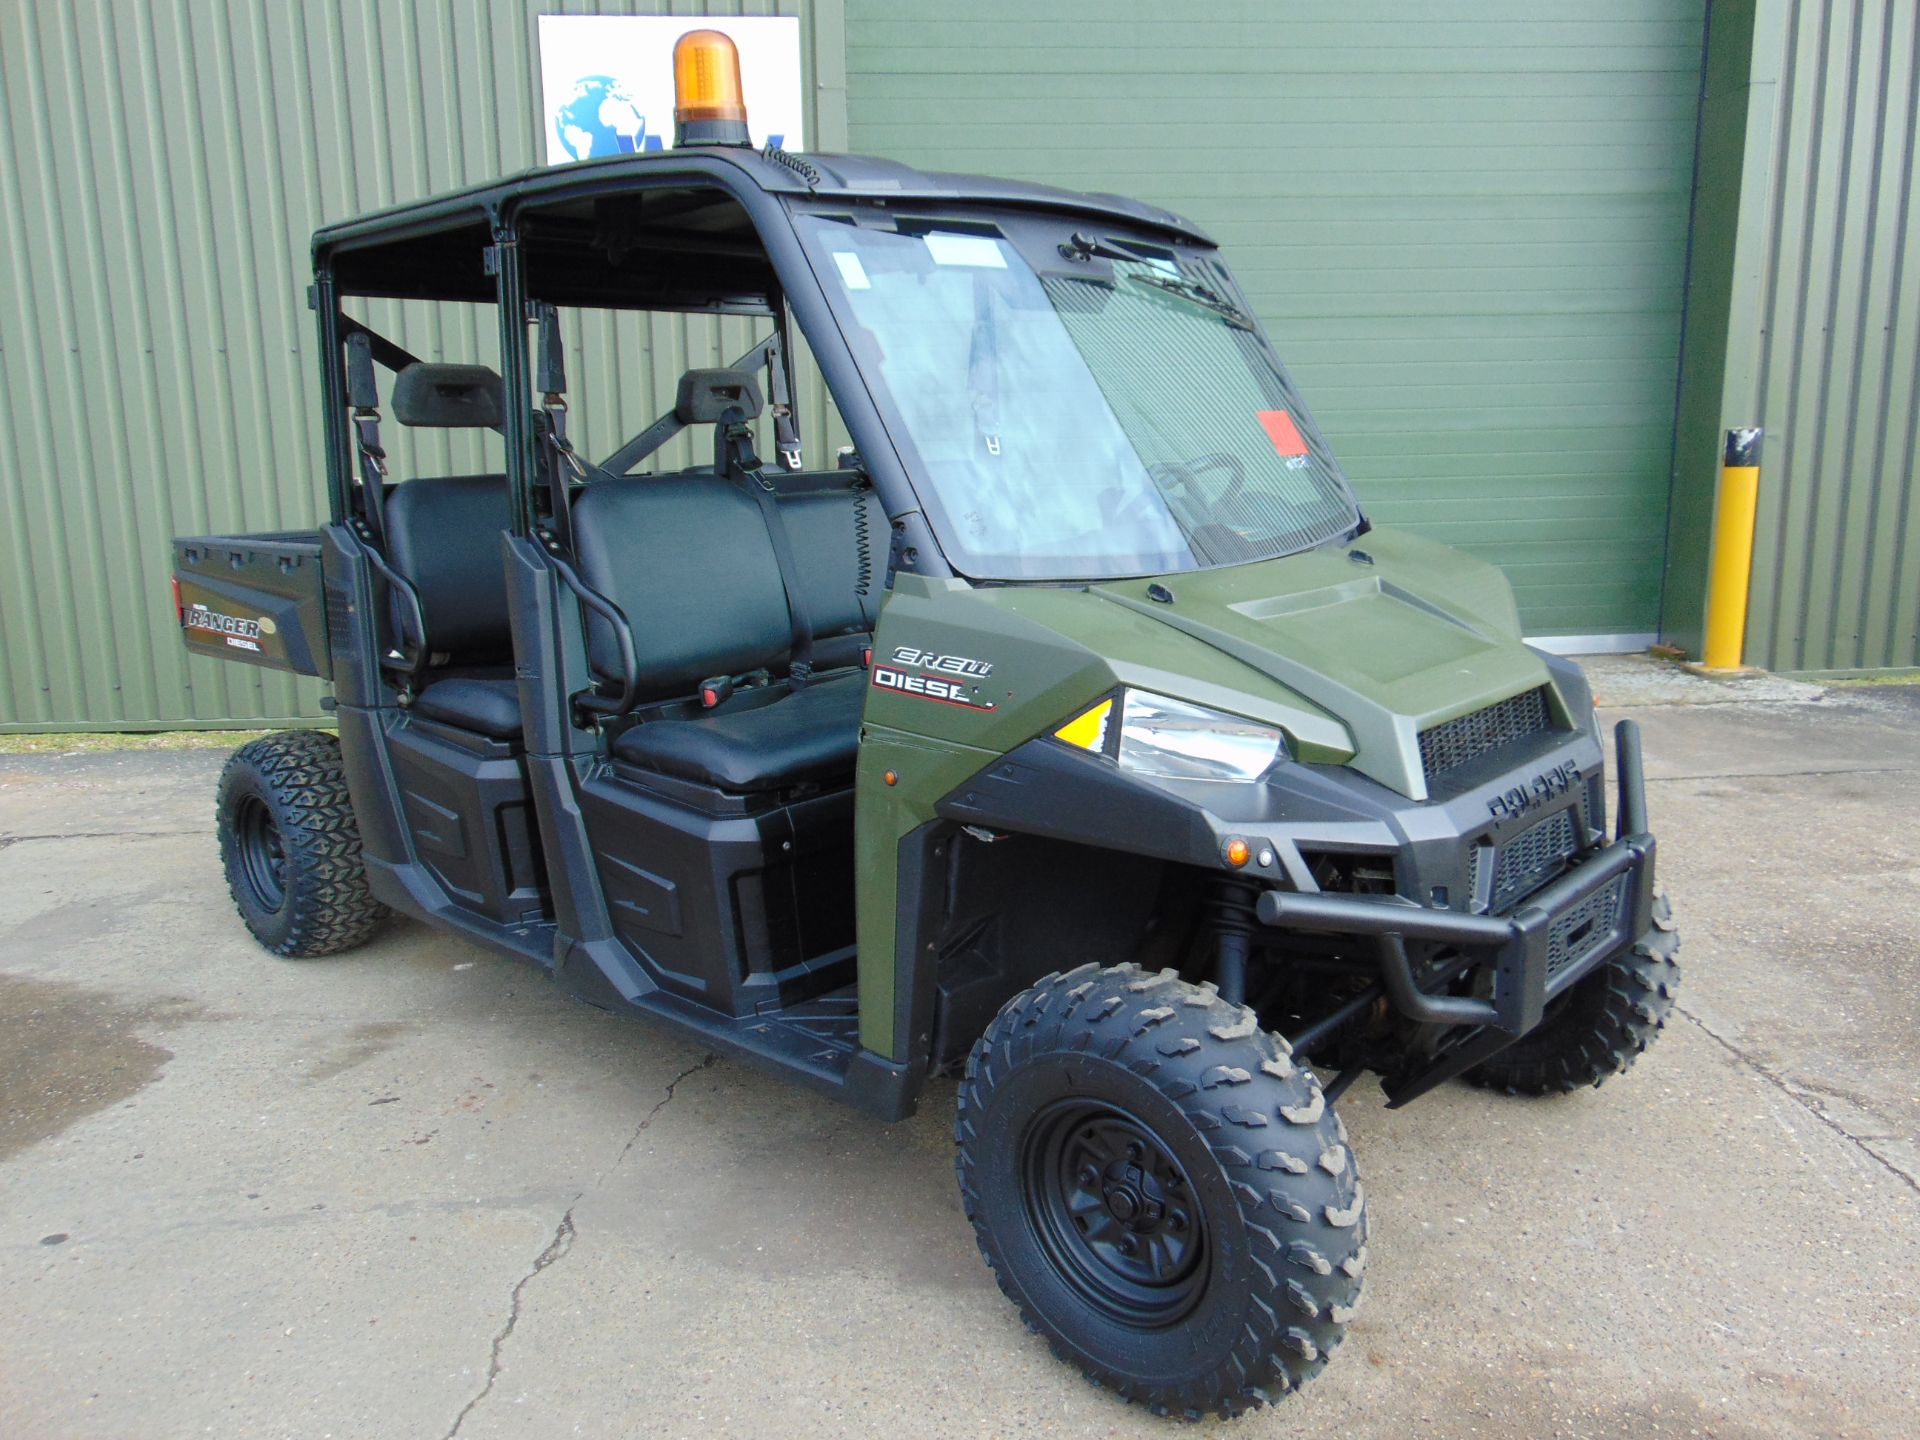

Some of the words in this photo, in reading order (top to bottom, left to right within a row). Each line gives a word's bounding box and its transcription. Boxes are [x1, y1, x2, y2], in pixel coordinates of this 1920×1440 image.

[189, 609, 259, 638] RANGER
[226, 636, 260, 652] DIESEL
[892, 646, 994, 679] CREW
[875, 668, 993, 707] DIESE
[1486, 757, 1582, 830] POLARIS
